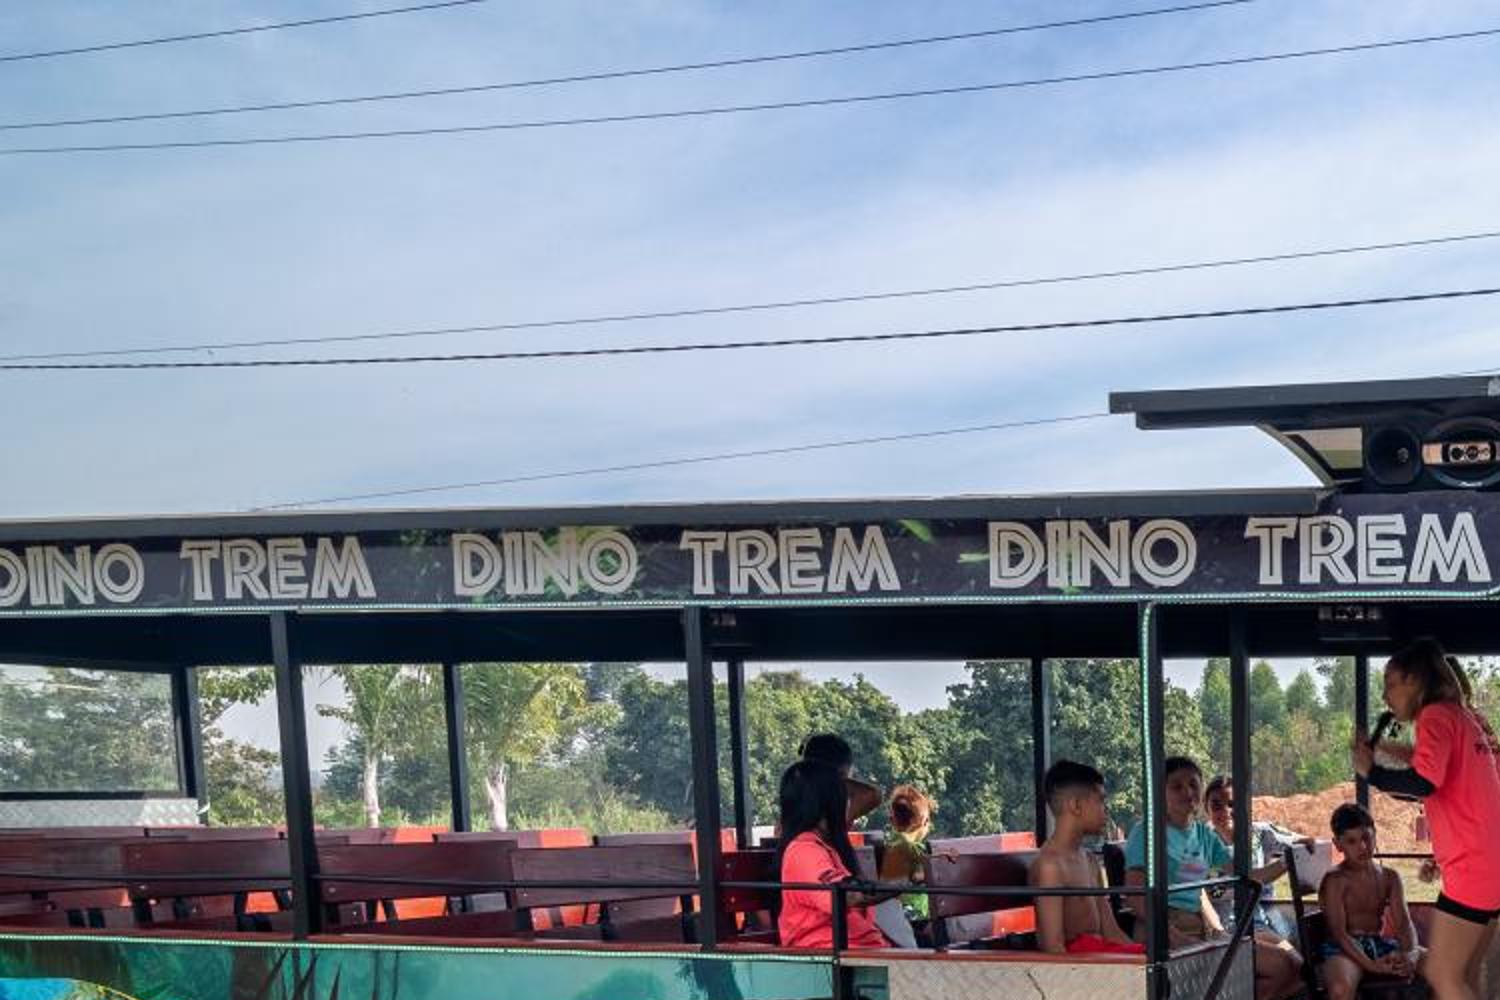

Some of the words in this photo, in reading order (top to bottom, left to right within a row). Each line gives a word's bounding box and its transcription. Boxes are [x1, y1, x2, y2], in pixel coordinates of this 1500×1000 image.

[0, 543, 145, 606] DINO
[180, 537, 377, 601] TREM
[451, 528, 639, 597] DINO
[680, 525, 900, 597] TREM
[988, 518, 1198, 590] DINO
[1244, 512, 1492, 586] TREM
